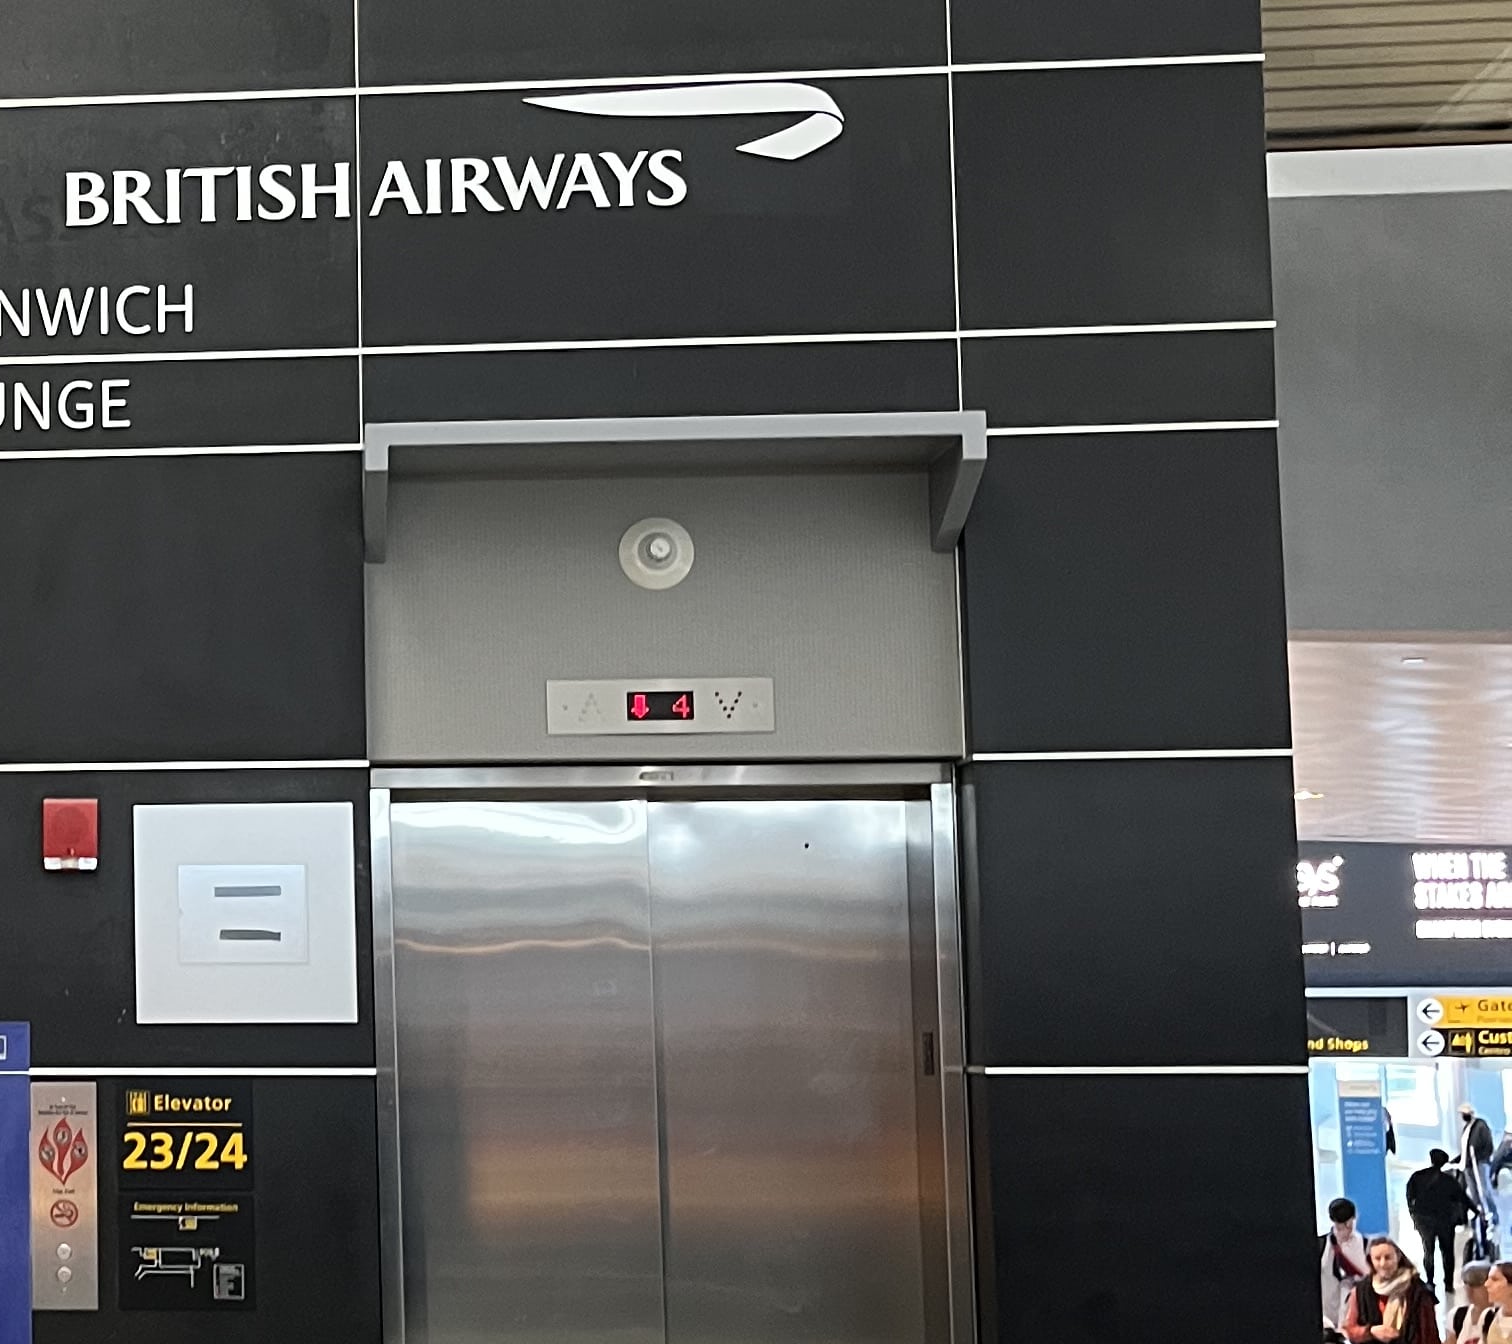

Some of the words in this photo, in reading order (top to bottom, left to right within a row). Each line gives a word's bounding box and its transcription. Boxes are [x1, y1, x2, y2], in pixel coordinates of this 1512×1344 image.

[65, 162, 351, 227] BRITISH
[368, 149, 687, 217] AIRWAYS
[672, 694, 690, 718] 4
[1327, 1037, 1369, 1053] Shops
[154, 1094, 232, 1111] Elevator
[123, 1131, 248, 1170] 23/24
